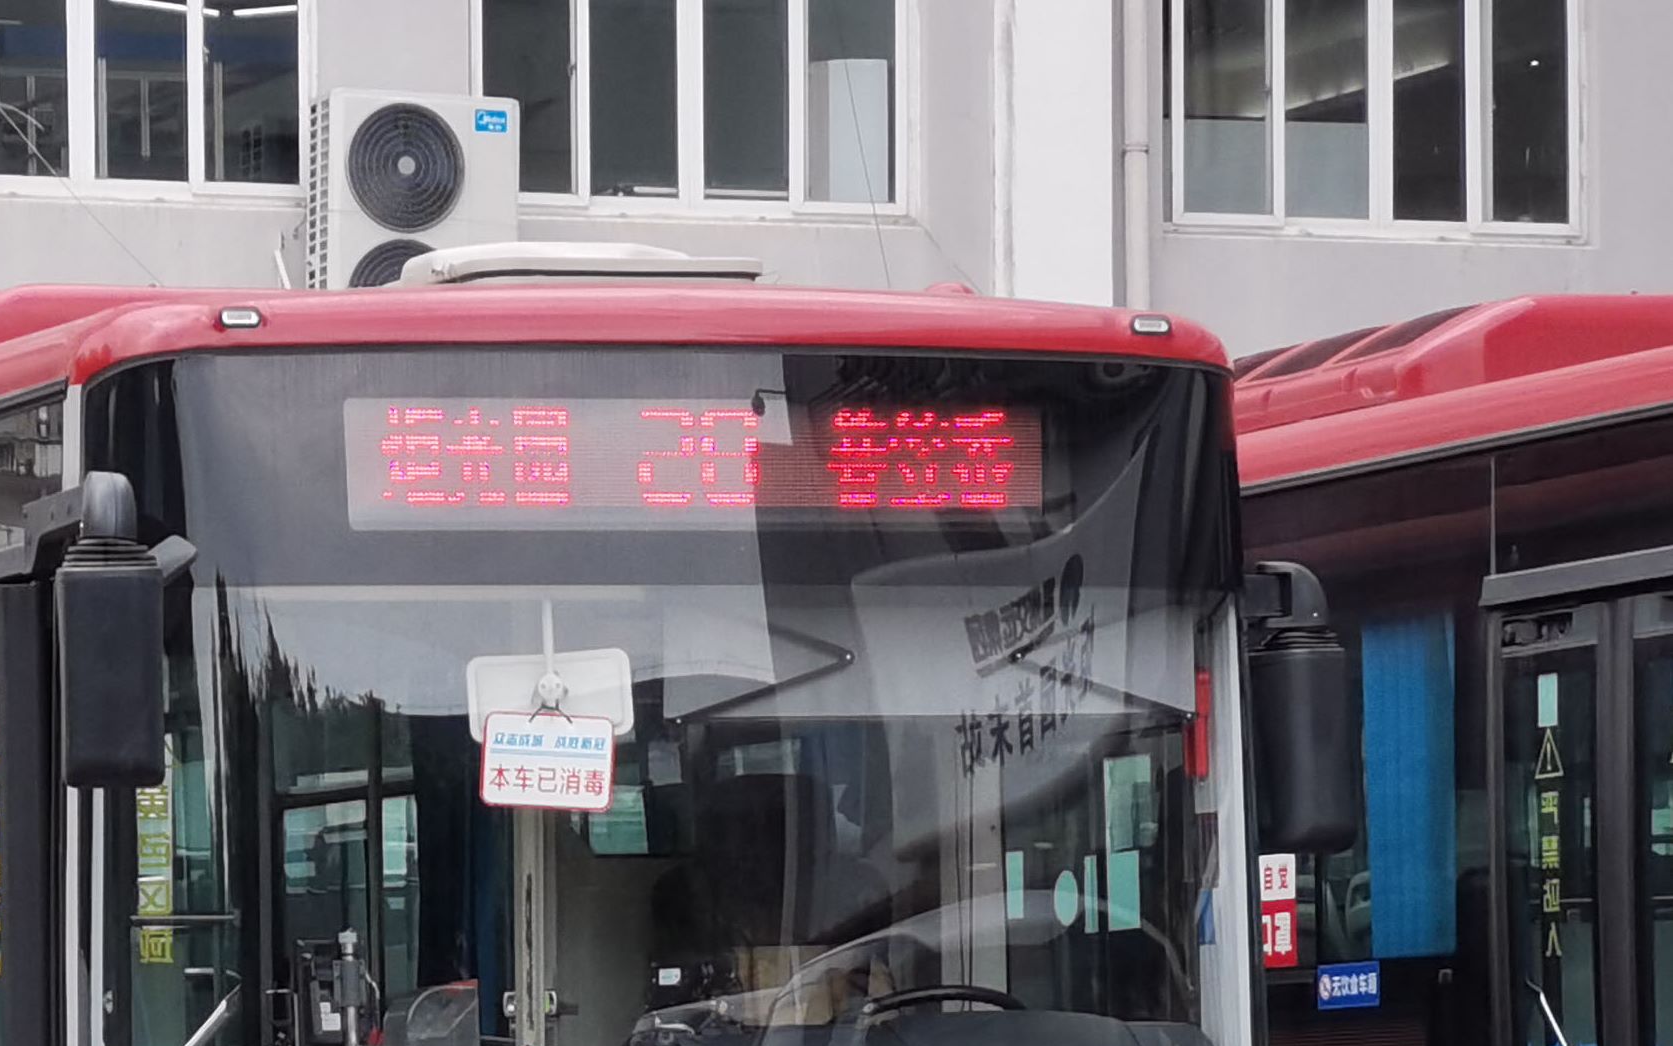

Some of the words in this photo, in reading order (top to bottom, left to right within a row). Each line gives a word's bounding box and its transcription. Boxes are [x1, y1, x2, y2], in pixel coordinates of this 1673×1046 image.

[489, 764, 605, 796] 本车已消毒
